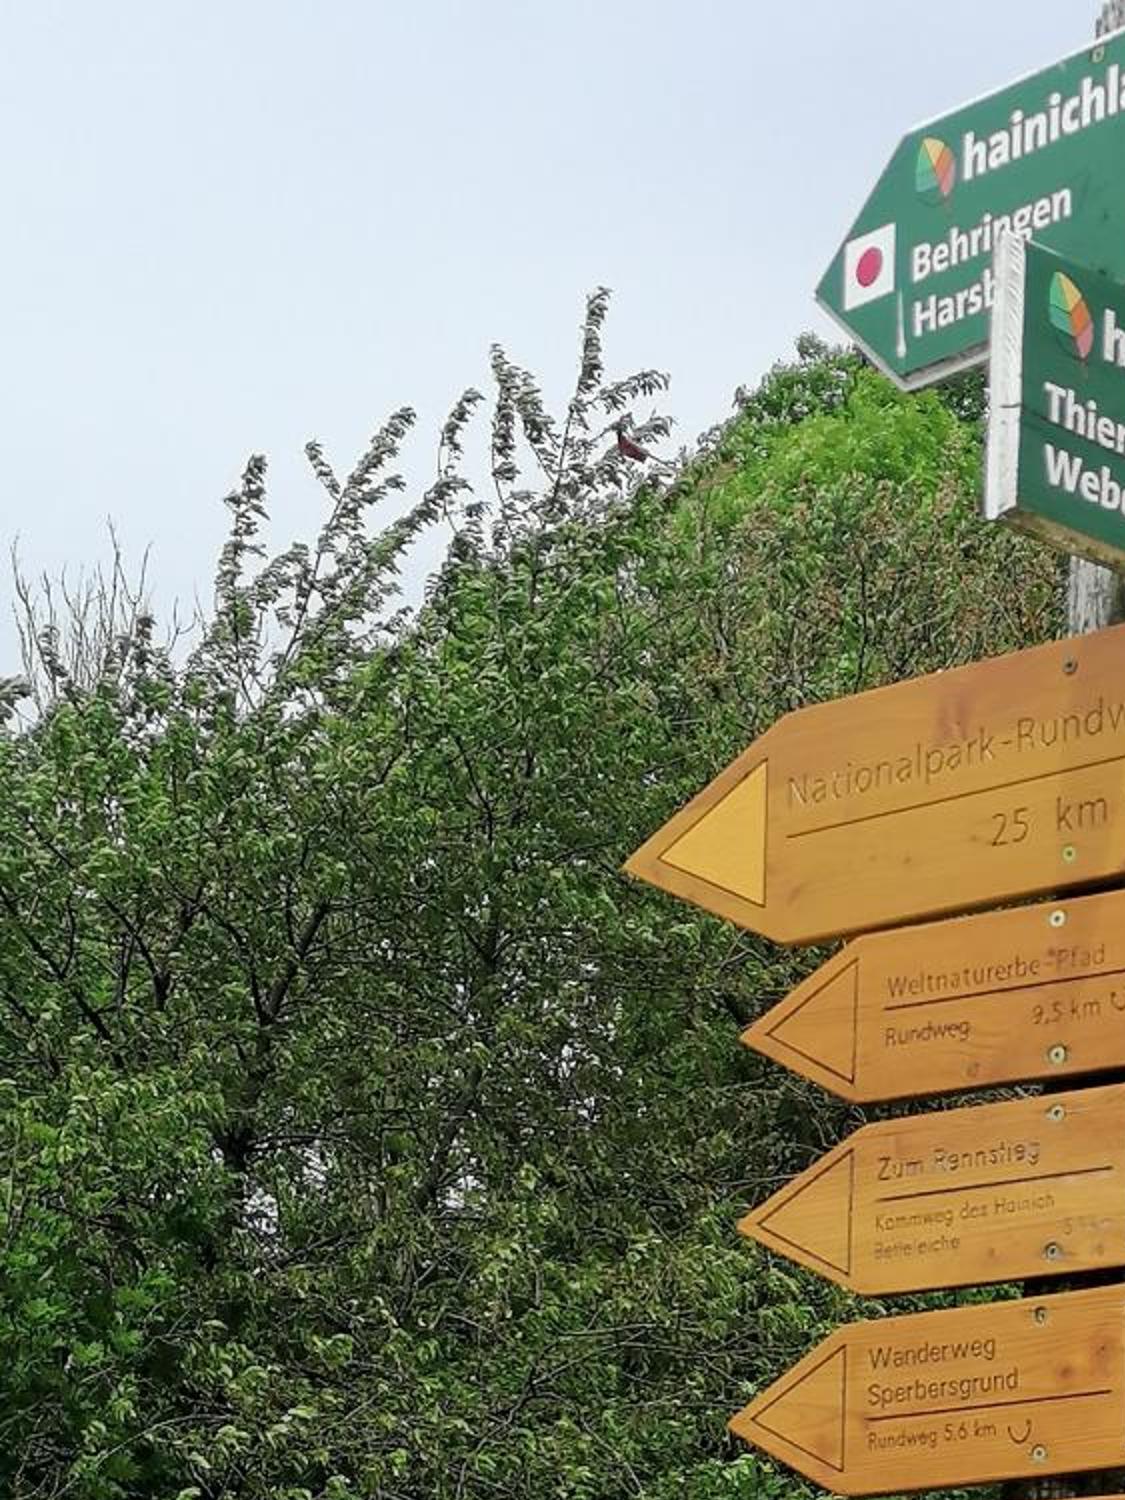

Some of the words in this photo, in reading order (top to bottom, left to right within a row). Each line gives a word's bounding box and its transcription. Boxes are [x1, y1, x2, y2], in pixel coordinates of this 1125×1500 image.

[990, 807, 1029, 847] 25
[1055, 794, 1108, 831] km
[885, 1020, 970, 1048] Rundweg
[877, 1154, 924, 1182] Zum
[933, 1141, 1040, 1174] Rennstieg
[868, 1337, 996, 1370] Wanderweg
[867, 1369, 1019, 1409] Sperbersgrund
[867, 1426, 937, 1450] Rundweg
[973, 1420, 997, 1438] km
